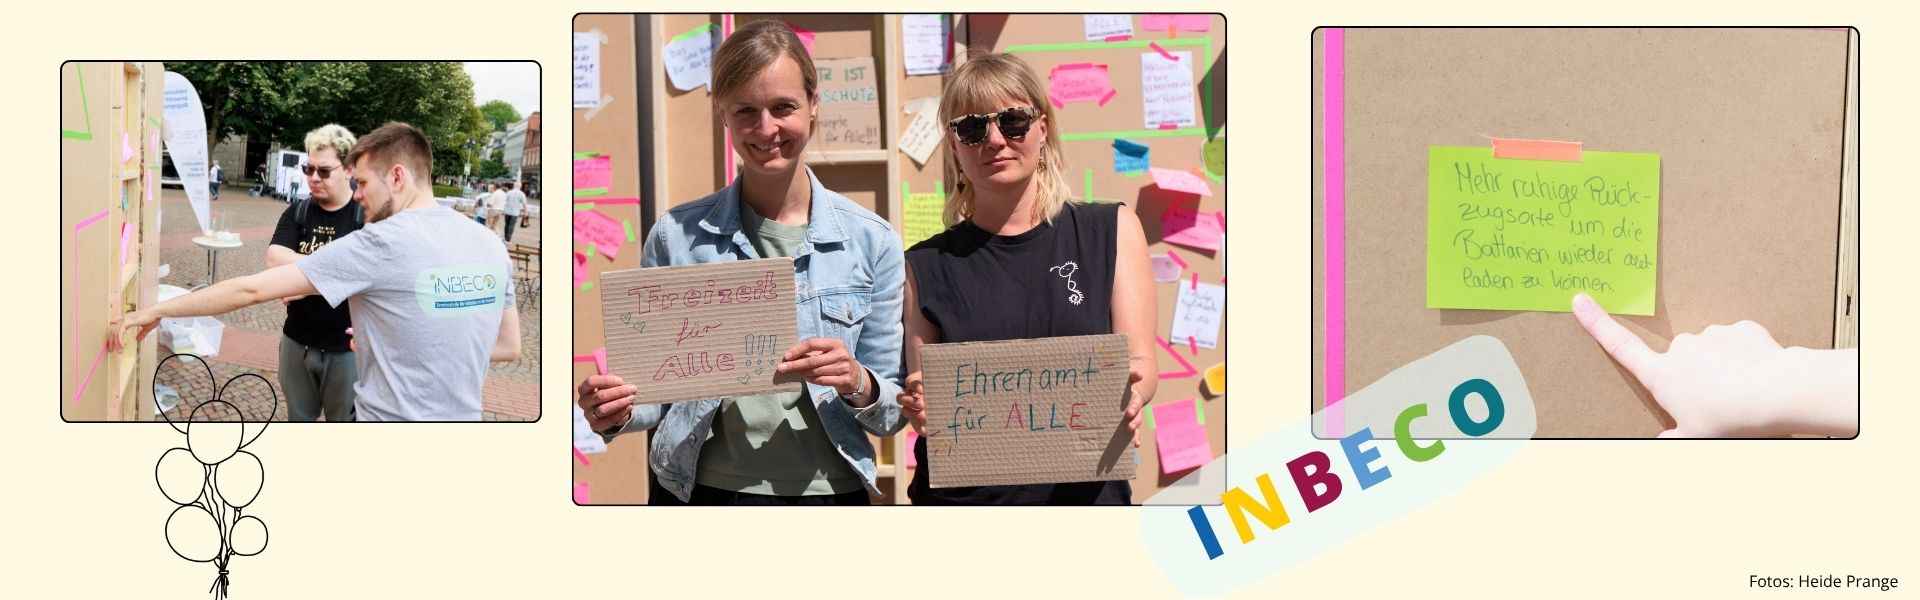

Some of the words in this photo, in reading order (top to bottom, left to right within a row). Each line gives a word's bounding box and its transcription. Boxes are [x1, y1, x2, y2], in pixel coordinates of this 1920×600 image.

[816, 66, 833, 82] TZ
[844, 66, 867, 82] IST
[818, 86, 877, 103] SCHUTZ
[1454, 161, 1503, 195] Mehr
[1512, 171, 1579, 218] ruhige
[1457, 202, 1554, 231] zugsorte
[1570, 219, 1605, 236] um
[1612, 216, 1642, 242] die
[1558, 244, 1613, 266] wieder
[1462, 266, 1513, 289] laden
[1520, 276, 1544, 289] zu
[628, 271, 778, 315] Freizeit
[675, 317, 722, 347] für
[653, 352, 735, 381] Alle
[955, 357, 1100, 398] Ehrenamt
[947, 406, 988, 444] für
[1004, 401, 1087, 432] ALLE
